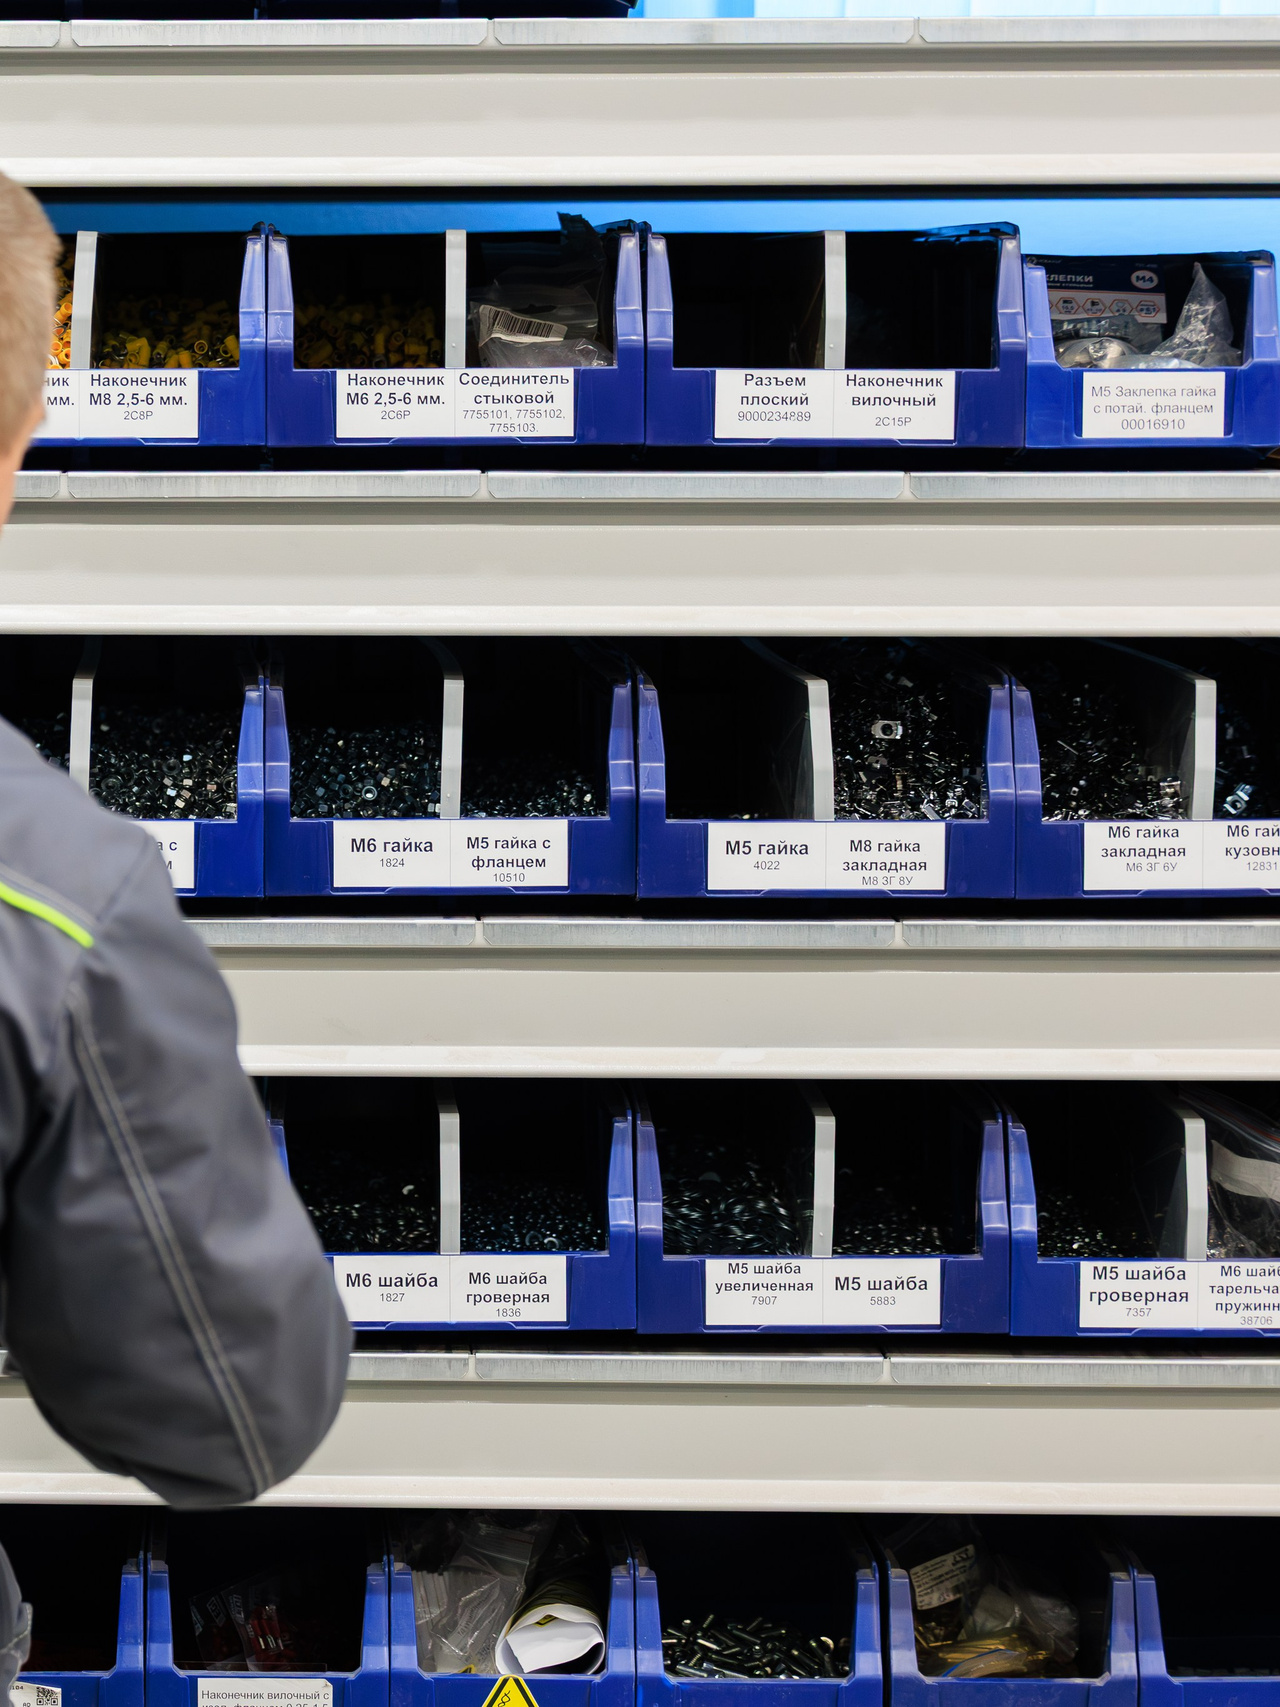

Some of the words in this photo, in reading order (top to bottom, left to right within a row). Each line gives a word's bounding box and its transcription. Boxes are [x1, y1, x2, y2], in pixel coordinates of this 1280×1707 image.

[90, 373, 187, 387] Наконечник
[347, 373, 445, 387] Наконечник
[458, 372, 570, 388] Соединитель
[744, 373, 806, 387] Разъем
[846, 373, 943, 388] Наконечник
[473, 390, 554, 405] стыковой
[1091, 385, 1112, 398] М5
[1115, 385, 1177, 398] Заклепка
[1180, 385, 1217, 397] гайка
[46, 396, 75, 406] мм.
[89, 392, 112, 406] М8
[116, 392, 155, 408] 2,5-6
[159, 395, 188, 406] мм.
[346, 392, 369, 406] М6
[373, 391, 412, 408] 2,5-6
[417, 395, 445, 405] мм.
[740, 392, 809, 406] плоский
[851, 393, 936, 407] вилочный
[462, 409, 512, 420] 7755101,
[1093, 404, 1101, 414] с
[1104, 402, 1147, 414] потай.
[1150, 402, 1214, 416] фланцем
[489, 422, 539, 433] 7755103.
[1121, 418, 1186, 431] 00016910
[1108, 825, 1131, 839] М6
[1136, 825, 1180, 839] гайка
[1227, 824, 1250, 838] М6
[350, 837, 377, 853] М6
[383, 837, 434, 853] гайка
[466, 836, 490, 850] М5
[494, 836, 537, 850] гайка
[542, 839, 551, 850] с
[725, 840, 752, 856] М5
[758, 840, 809, 856] гайка
[849, 839, 872, 853] М8
[877, 839, 921, 853] гайка
[1100, 847, 1186, 860] закладная
[379, 857, 405, 868] 1824
[471, 855, 546, 872] фланцем
[753, 860, 781, 871] 4022
[842, 861, 927, 874] закладная
[1126, 862, 1143, 872] М6
[493, 872, 526, 883] 10510
[861, 875, 879, 886] М8
[728, 1262, 749, 1275] М5
[753, 1262, 801, 1275] шайба
[1092, 1265, 1119, 1281] М5
[1125, 1265, 1186, 1281] шайба
[1220, 1265, 1242, 1277] М6
[346, 1272, 372, 1288] М6
[378, 1272, 438, 1288] шайба
[468, 1271, 491, 1285] М6
[496, 1271, 548, 1285] шайба
[835, 1276, 862, 1291] М5
[867, 1275, 928, 1291] шайба
[715, 1282, 814, 1295] увеличенная
[379, 1292, 406, 1303] 1827
[466, 1293, 550, 1307] гроверная
[751, 1295, 778, 1306] 7907
[869, 1295, 897, 1306] 5883
[1089, 1291, 1189, 1306] гроверная
[495, 1307, 522, 1318] 1836
[1125, 1307, 1152, 1318] 7357
[1239, 1315, 1273, 1326] 38706
[201, 1689, 265, 1700] Наконечник
[267, 1690, 320, 1700] вилочный
[322, 1692, 330, 1701] с
